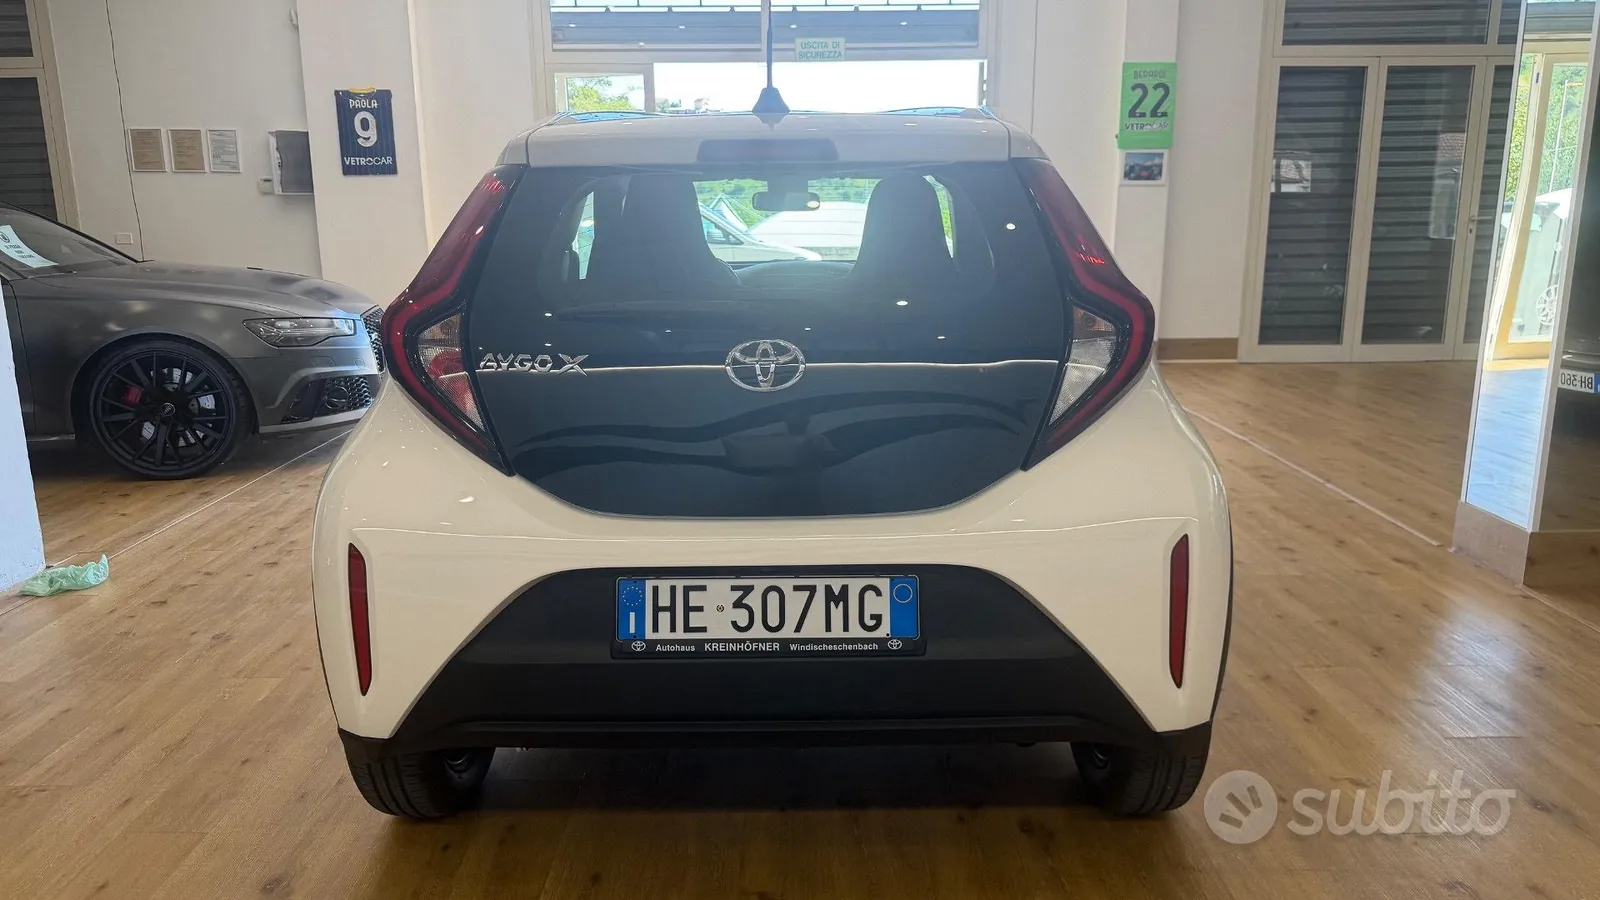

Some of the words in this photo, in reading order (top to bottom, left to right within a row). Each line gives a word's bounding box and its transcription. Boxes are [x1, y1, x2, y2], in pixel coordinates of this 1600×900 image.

[800, 40, 828, 50] USCITA
[832, 40, 840, 49] DI
[798, 50, 843, 60] SICUREZZA
[349, 98, 378, 109] PAOLA
[1128, 83, 1170, 118] 22
[354, 110, 378, 147] 9
[343, 156, 393, 166] VETROCAR
[480, 352, 553, 372] AYGO
[556, 353, 589, 377] X
[652, 585, 708, 633] HE
[730, 584, 883, 633] 307MG
[655, 643, 696, 652] Autohaus
[704, 640, 780, 652] KREINHÖFNER
[789, 642, 879, 652] Windischeschenbach
